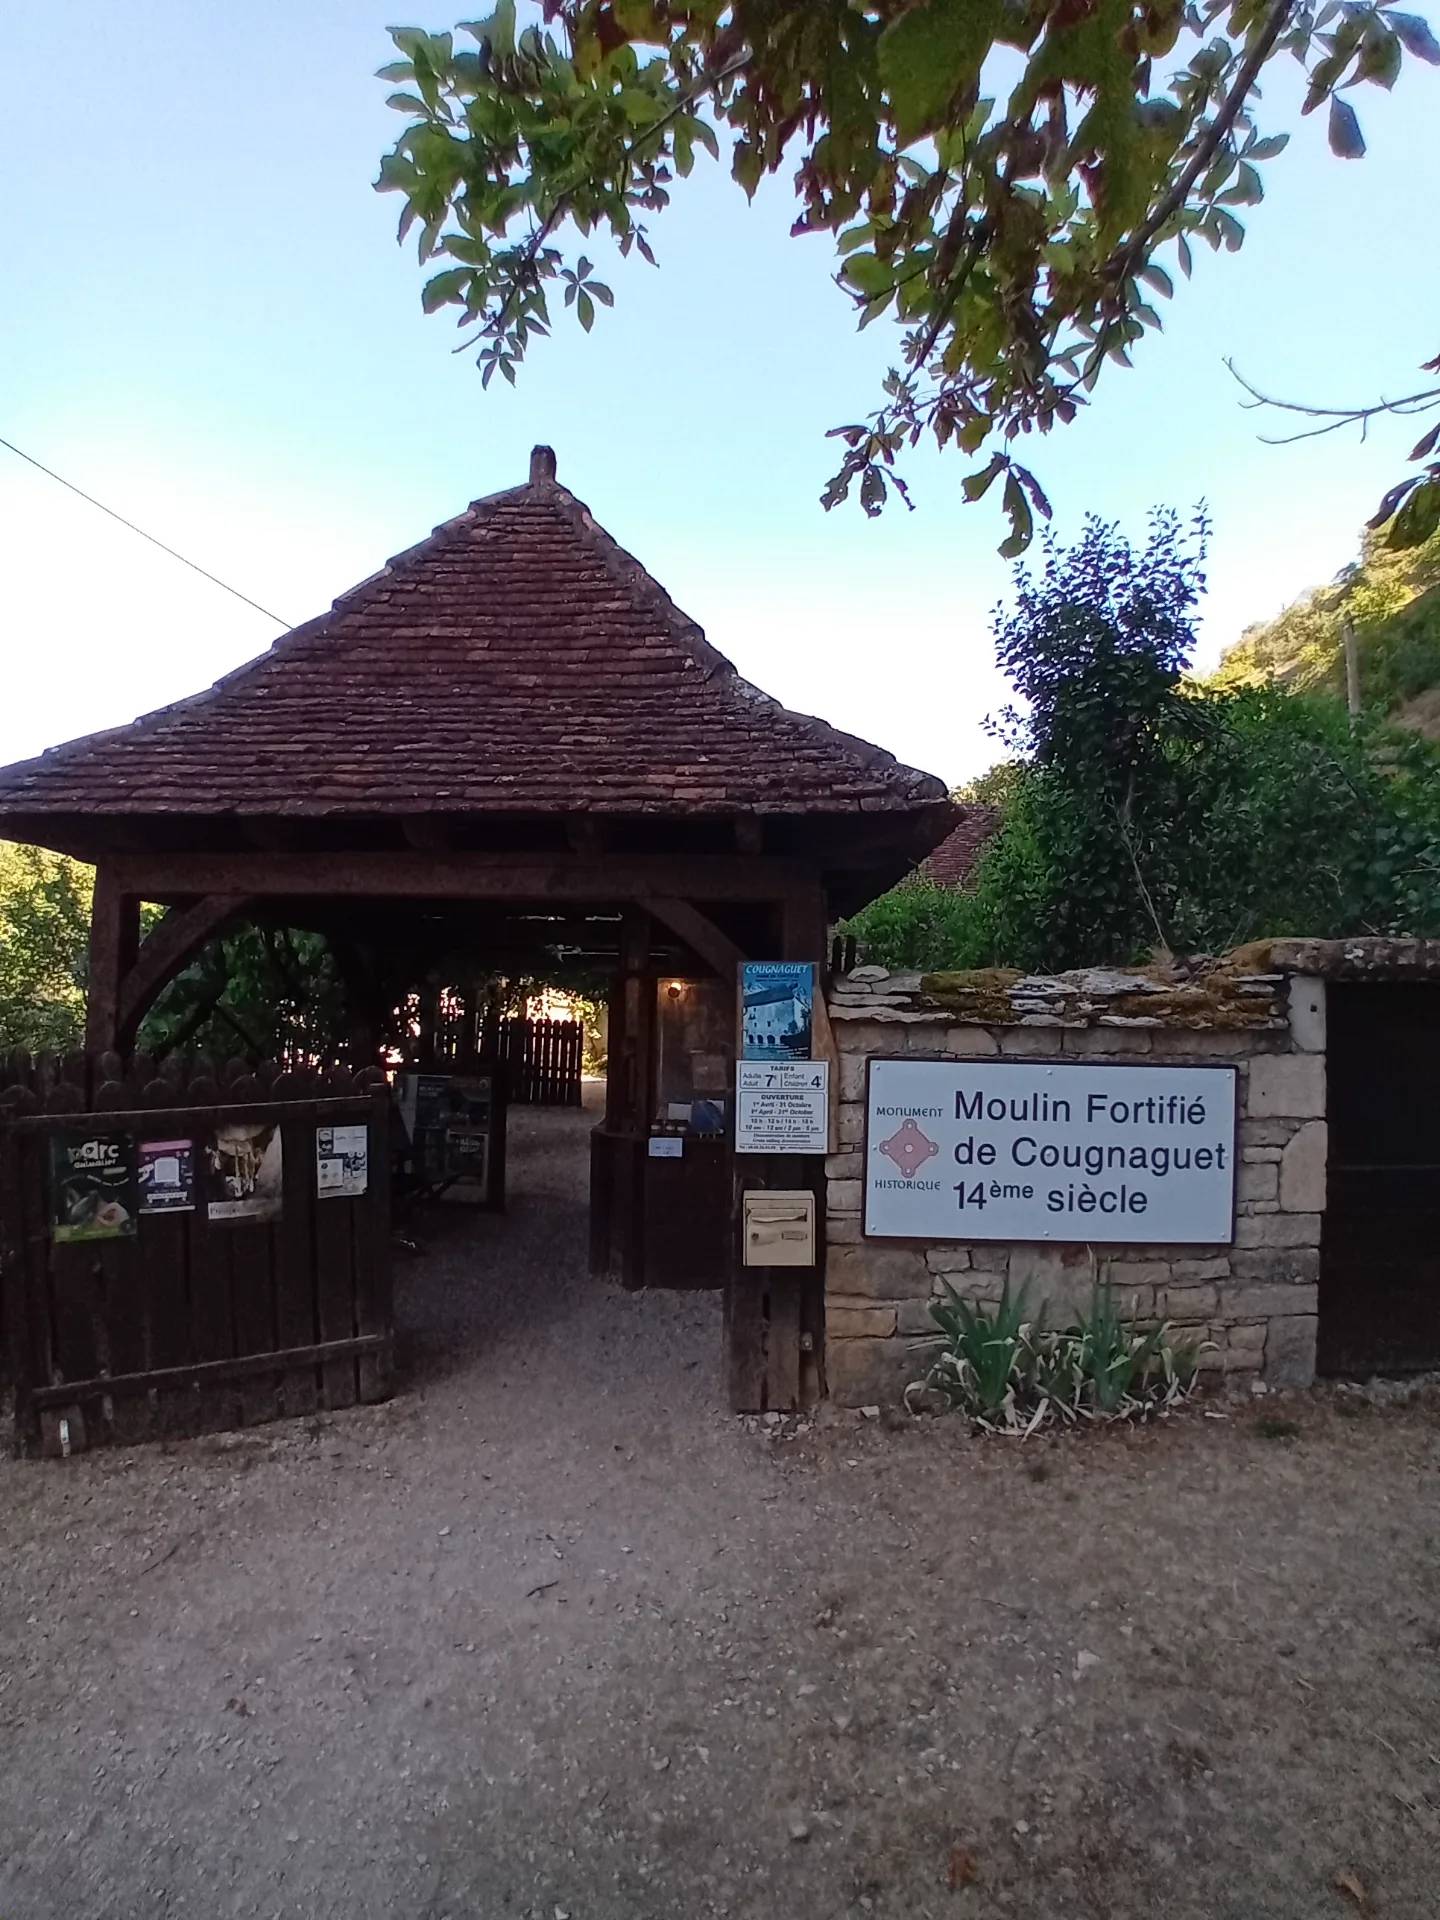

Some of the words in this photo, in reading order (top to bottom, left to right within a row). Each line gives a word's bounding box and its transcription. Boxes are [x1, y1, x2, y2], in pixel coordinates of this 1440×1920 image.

[745, 964, 809, 974] COUGNAGUET
[876, 1106, 943, 1117] MONUMENT
[954, 1090, 1071, 1122] Moulin
[1087, 1094, 1206, 1125] Fortifié
[954, 1136, 997, 1165] de
[1011, 1136, 1226, 1177] Cougnaguet
[874, 1179, 941, 1191] HISTORIQUE
[952, 1180, 1034, 1210] 14ème
[1046, 1183, 1148, 1214] siècle
